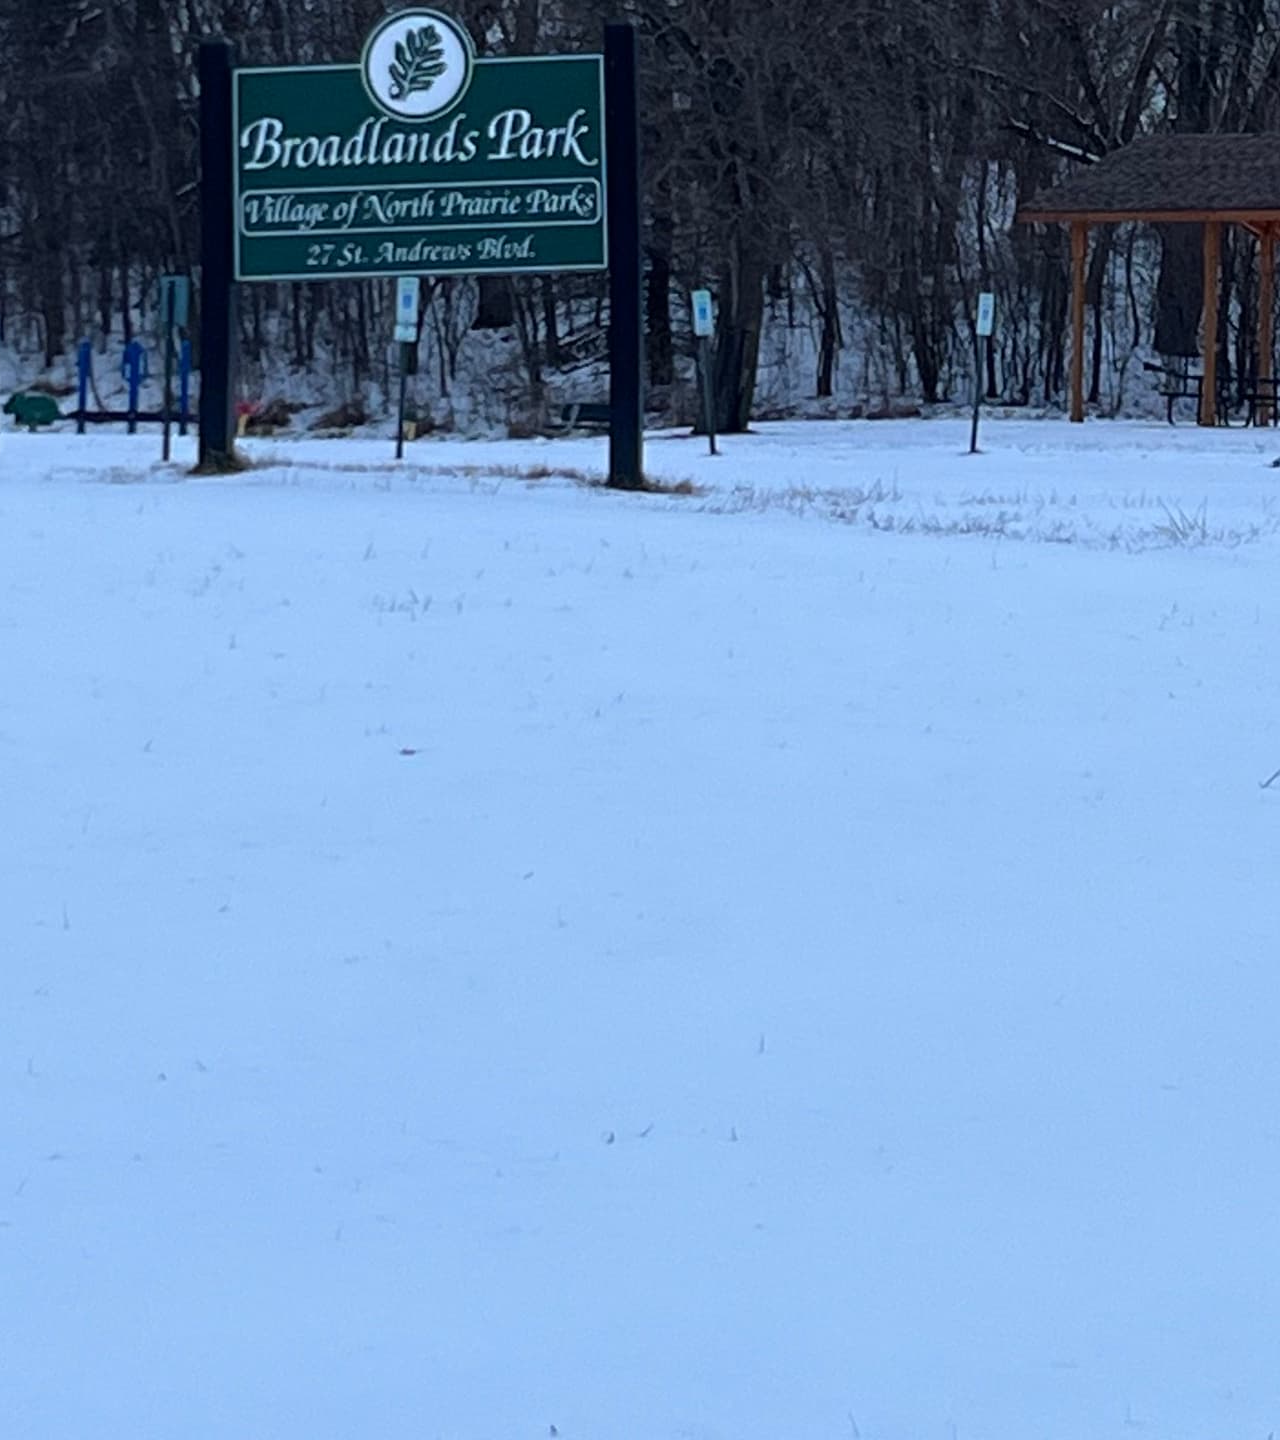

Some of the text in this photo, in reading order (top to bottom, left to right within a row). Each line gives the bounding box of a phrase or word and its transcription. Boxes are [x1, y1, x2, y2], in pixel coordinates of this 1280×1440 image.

[240, 108, 599, 172] Broadlands Park
[246, 187, 596, 231] Village of North Prairie Parks
[305, 236, 537, 267] 27 St. Andrews Blvd.
